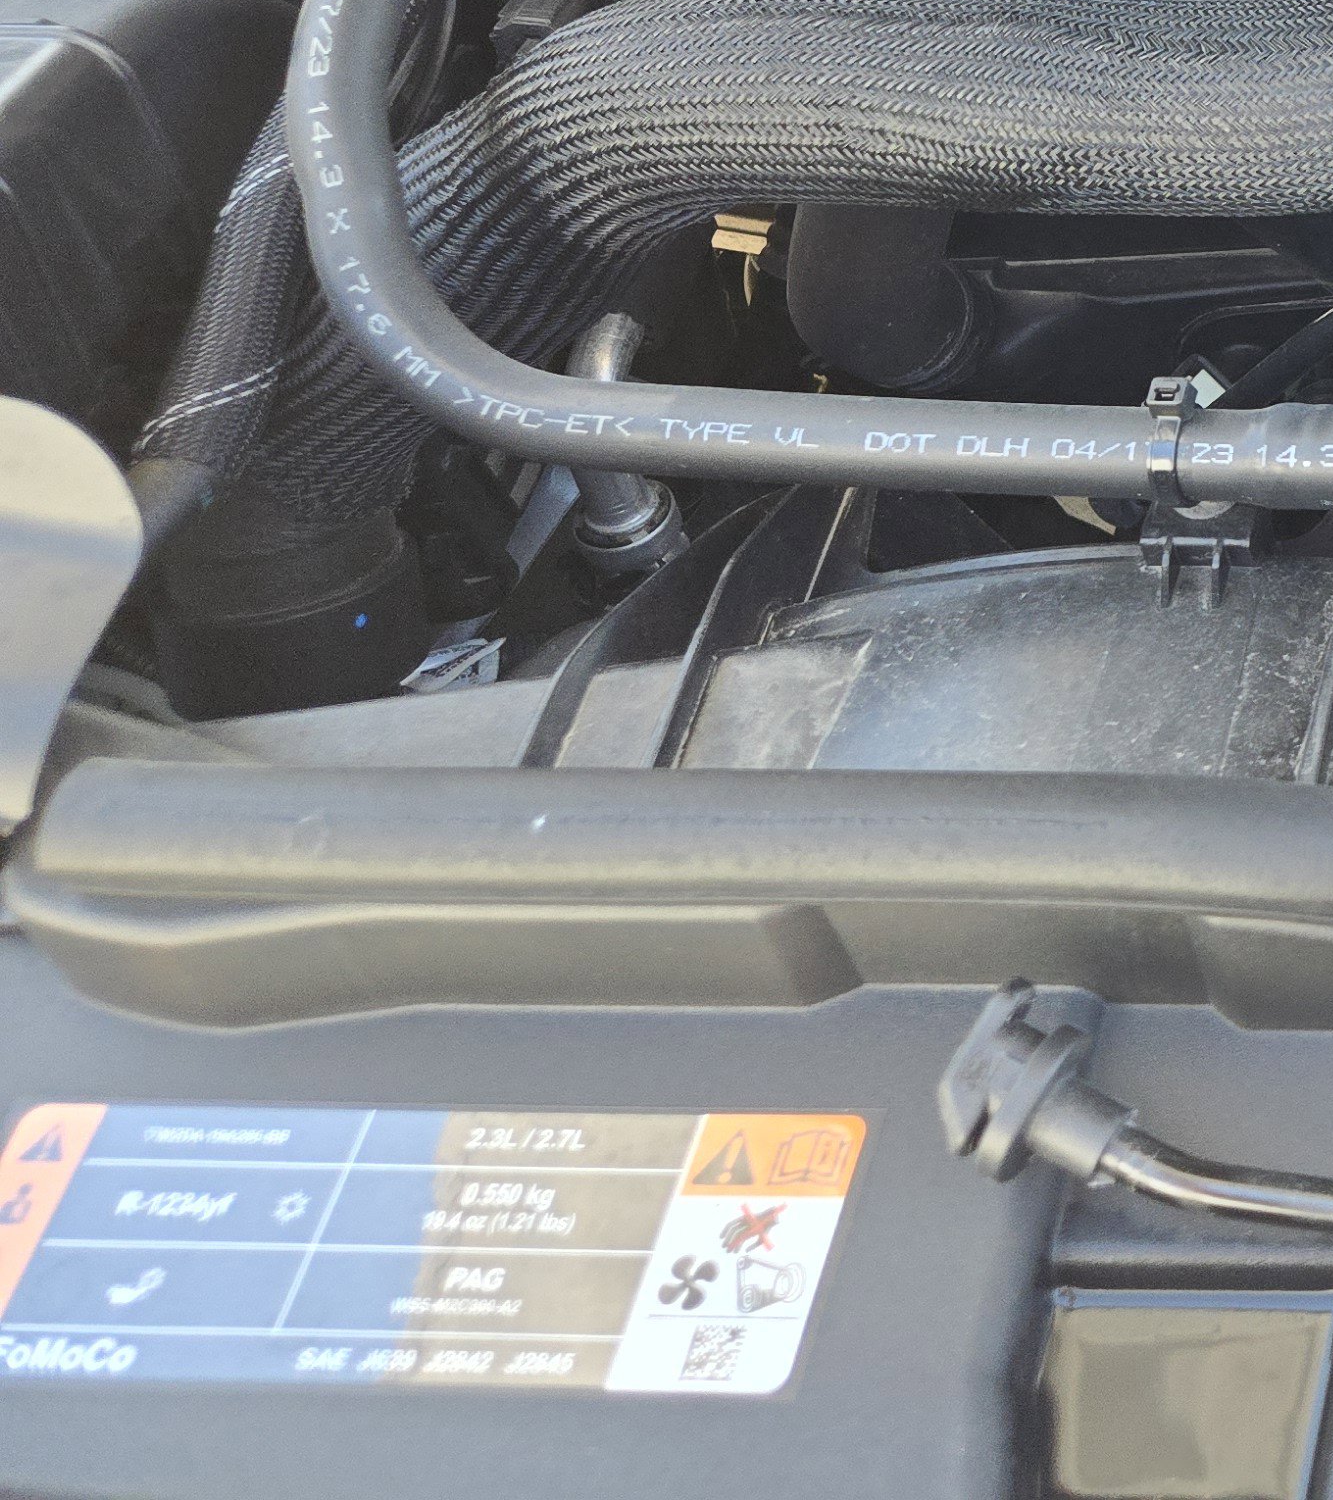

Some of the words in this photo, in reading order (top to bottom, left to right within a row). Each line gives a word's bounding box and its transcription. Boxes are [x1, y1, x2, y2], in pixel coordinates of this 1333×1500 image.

[307, 101, 344, 188] 14.3
[327, 208, 350, 234] X
[339, 256, 392, 335] 17.6
[393, 345, 441, 387] MM
[660, 418, 752, 444] TYPE
[864, 432, 936, 454] DOT
[956, 436, 1028, 457] DLH
[466, 1127, 517, 1149] 2.3L
[533, 1128, 586, 1151] 2.7L
[115, 1192, 238, 1222] R-1234yf
[459, 1182, 524, 1206] 0.550
[525, 1183, 556, 1211] kg
[465, 1215, 490, 1231] oz
[490, 1211, 534, 1234] (1.21
[539, 1211, 577, 1236] lbs)
[443, 1266, 506, 1291] PAG
[0, 1336, 138, 1372] FoMoCo
[294, 1347, 353, 1372] SAE
